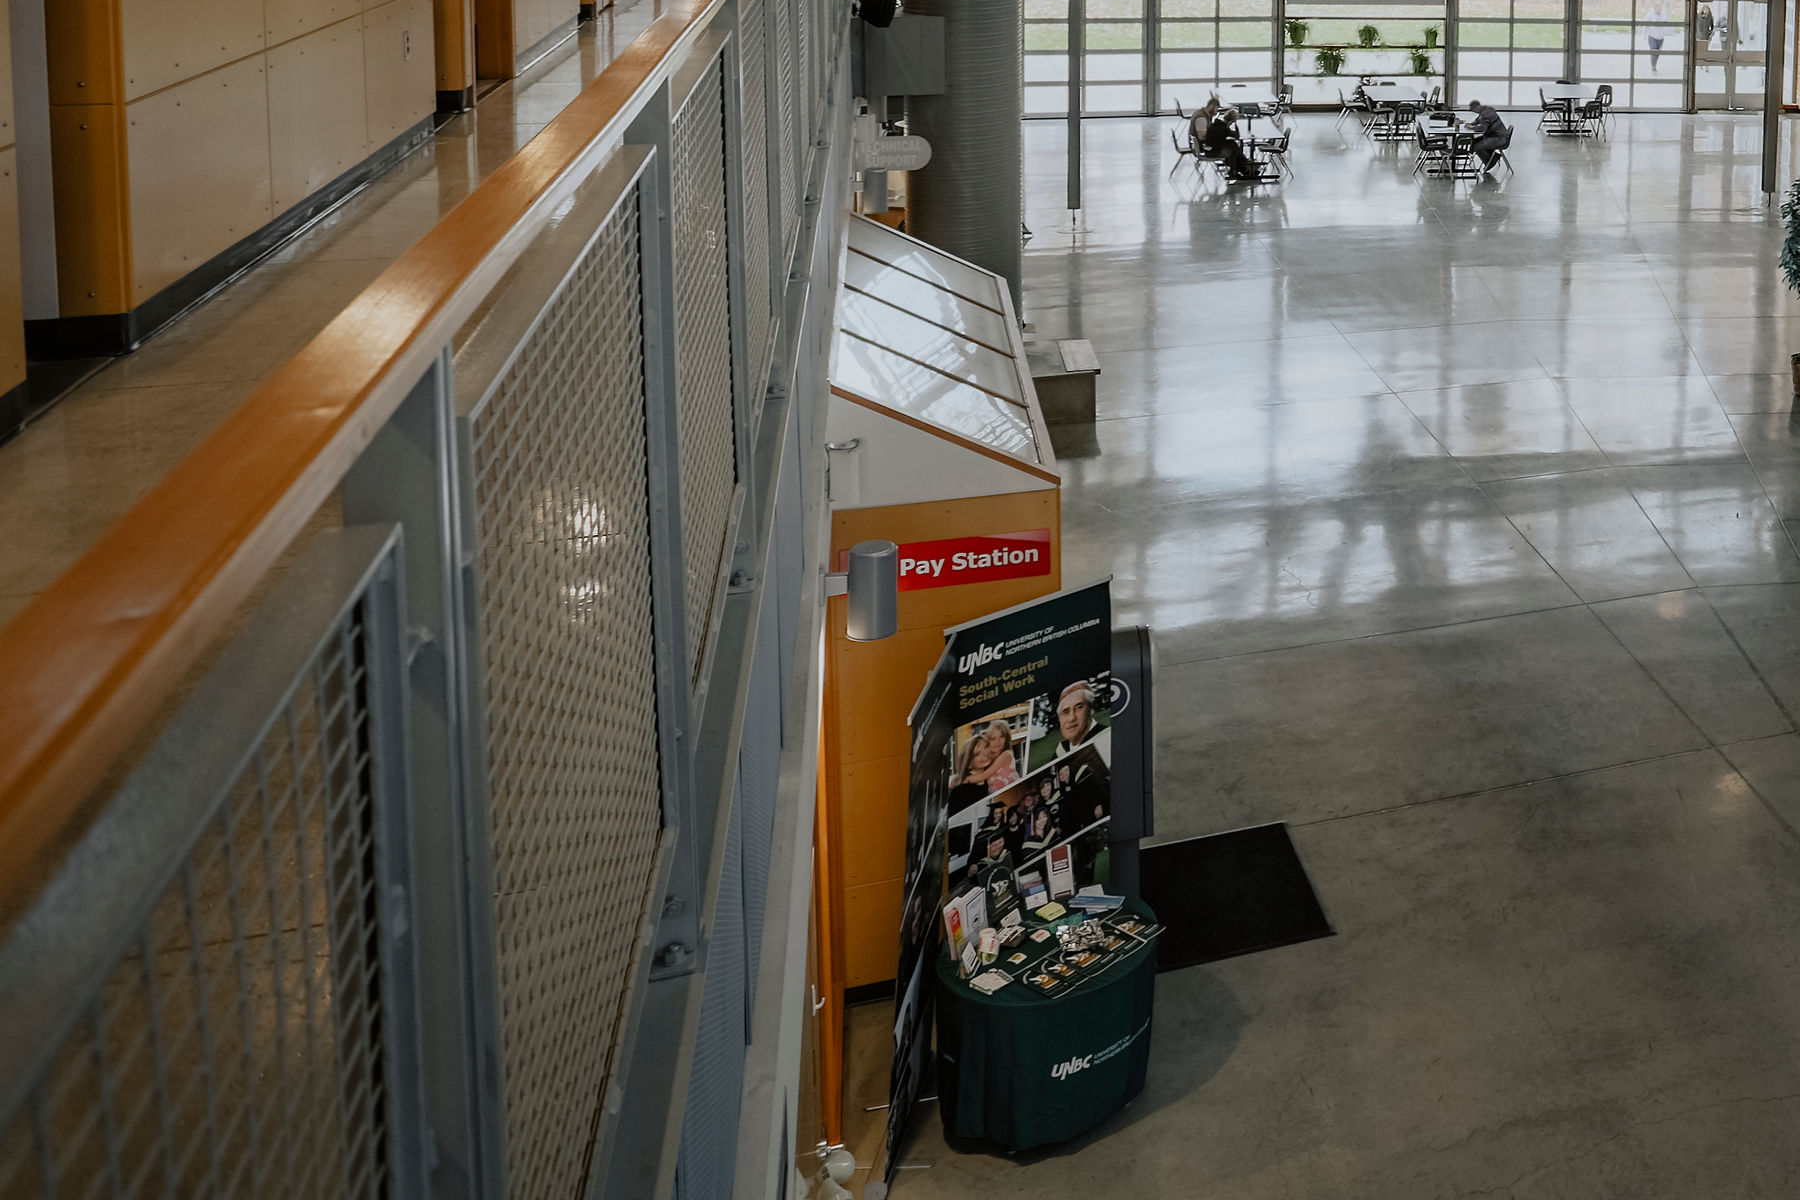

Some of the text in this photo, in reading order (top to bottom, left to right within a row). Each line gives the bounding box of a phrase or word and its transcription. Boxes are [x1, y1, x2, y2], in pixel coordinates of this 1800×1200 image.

[860, 140, 922, 153] TECHNICAL
[864, 155, 918, 169] SUPPORT
[900, 547, 1039, 578] Pay Station
[1005, 625, 1055, 648] UNIVERSITY OF
[1005, 618, 1100, 656] NORTHERN BRITISH COLUMBIA
[958, 642, 1004, 675] UNBC
[960, 656, 1049, 698] South-Central
[960, 673, 1036, 710] Social Work
[1051, 1054, 1092, 1080] UNBC
